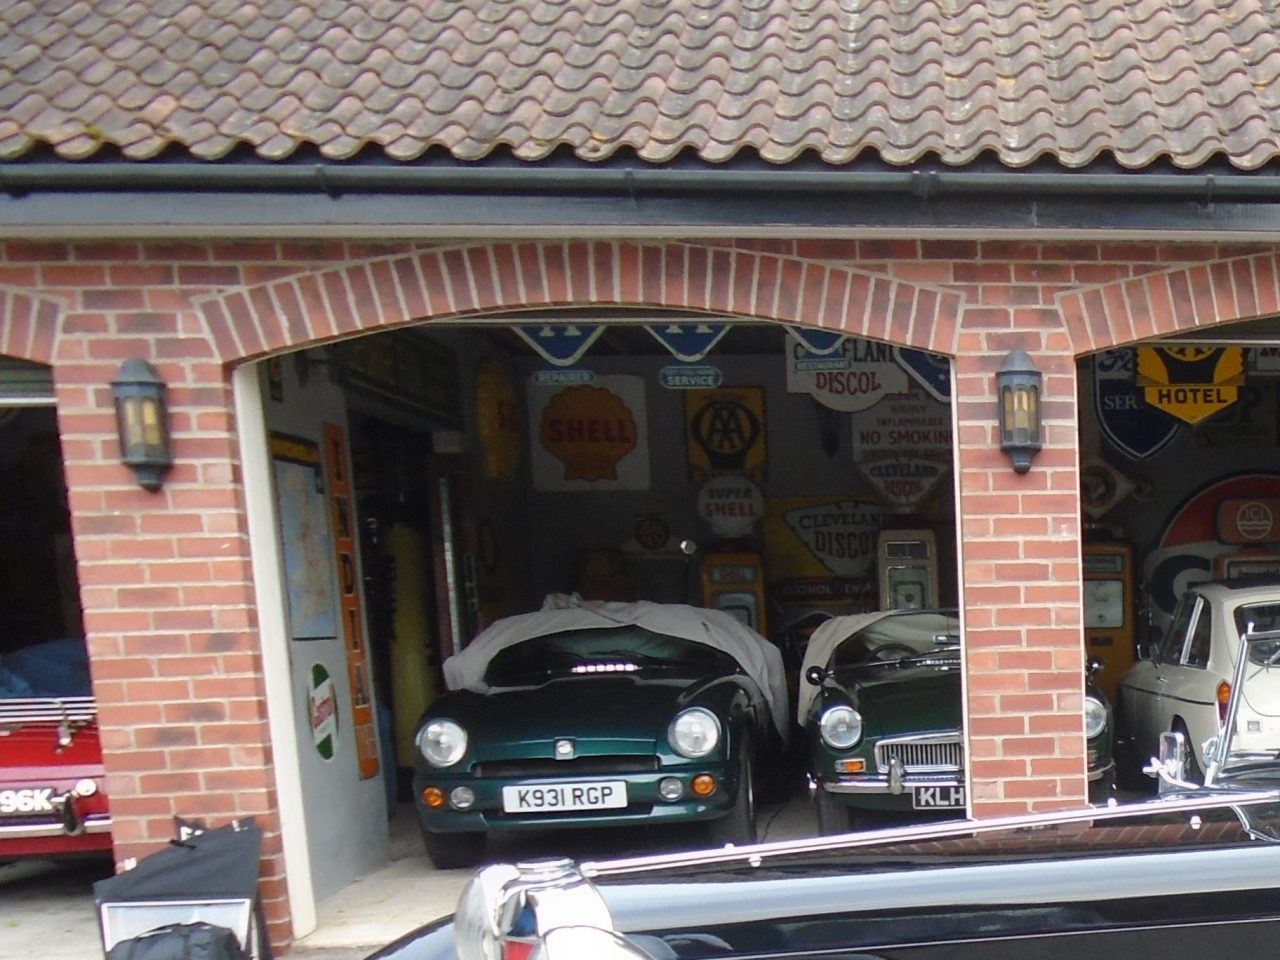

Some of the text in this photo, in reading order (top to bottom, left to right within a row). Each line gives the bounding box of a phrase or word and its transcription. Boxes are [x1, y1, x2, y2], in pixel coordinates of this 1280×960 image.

[667, 376, 715, 386] SERVICE
[816, 372, 881, 395] DISCOL
[1158, 388, 1227, 404] HOTEL
[549, 418, 632, 443] SHELL
[860, 430, 881, 445] NO
[709, 488, 752, 499] SUPER
[705, 503, 757, 517] SHELL
[518, 786, 612, 808] K931 RGP
